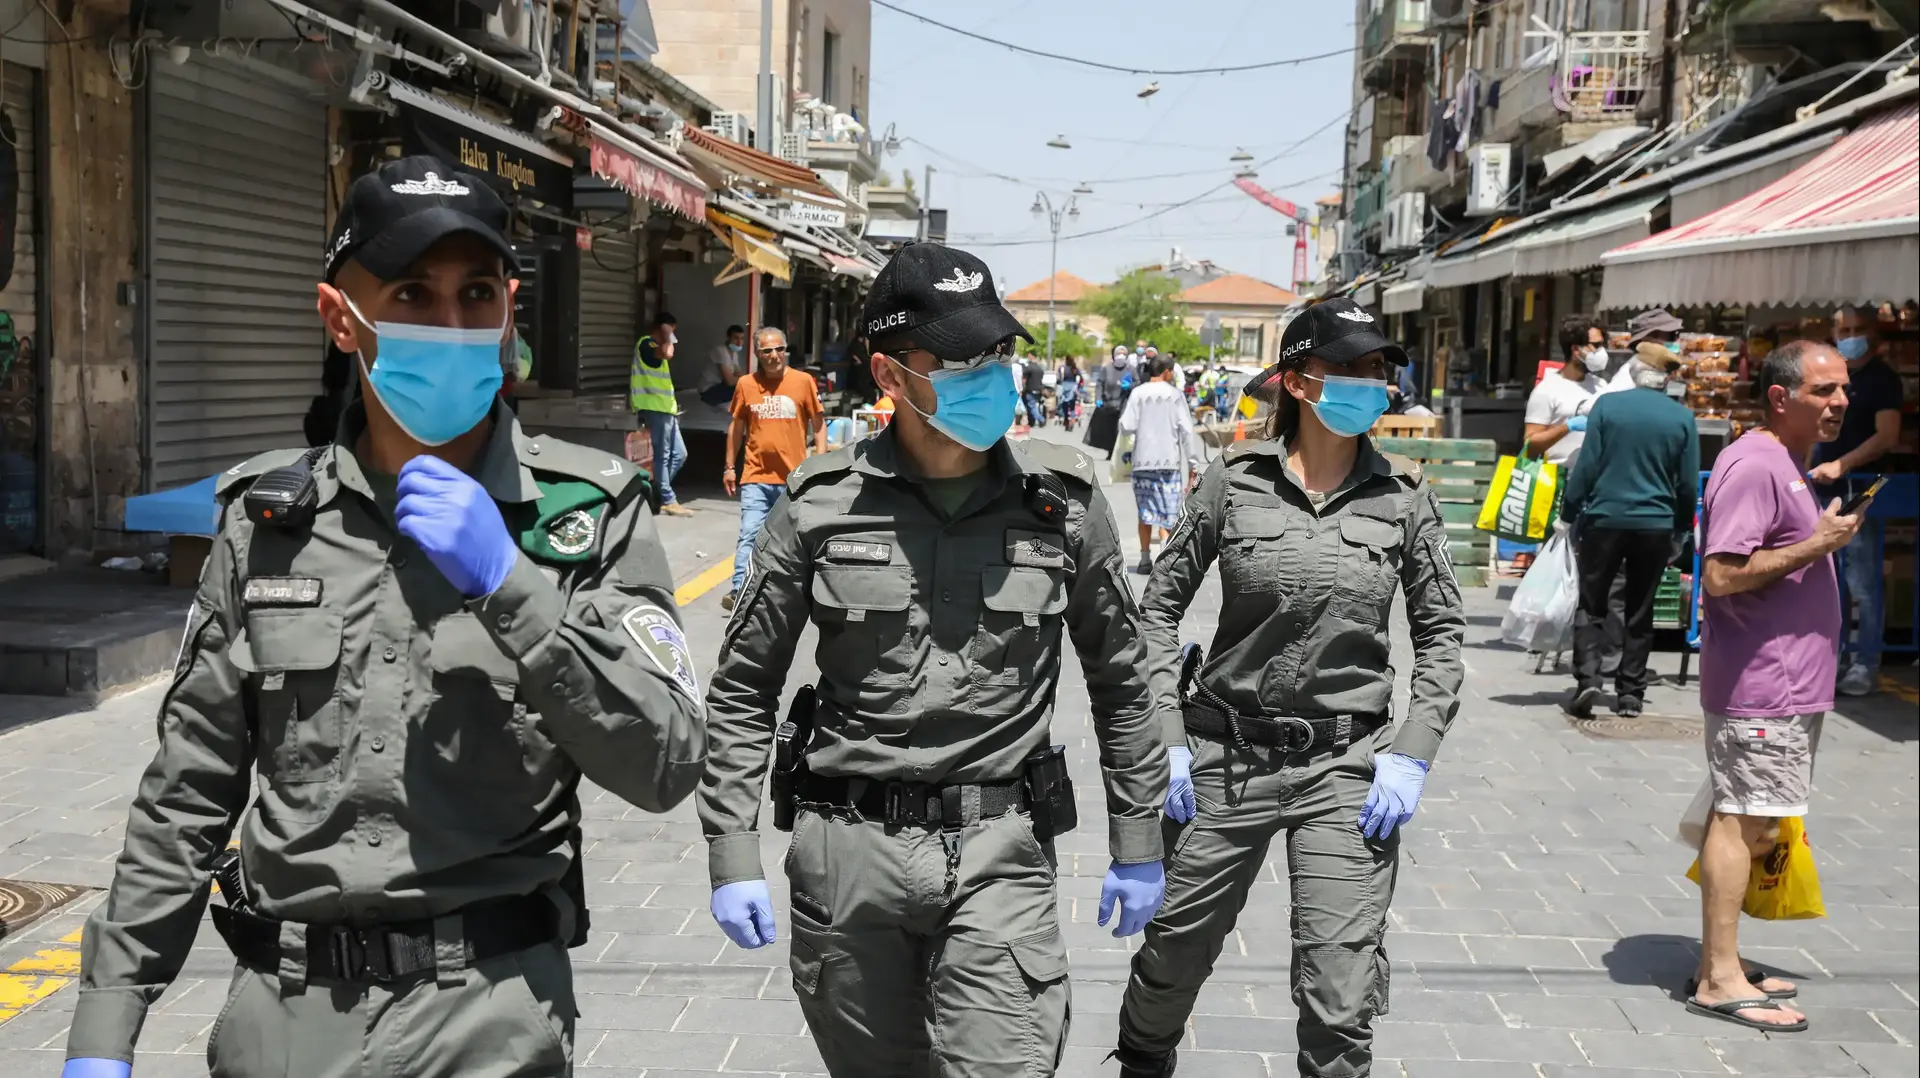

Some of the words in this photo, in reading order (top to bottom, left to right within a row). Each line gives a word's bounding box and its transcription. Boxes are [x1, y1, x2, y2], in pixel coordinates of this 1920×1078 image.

[460, 137, 489, 172] Halva
[496, 151, 536, 190] Kingdom
[868, 311, 906, 335] POLICE
[1282, 338, 1312, 361] POLICE
[749, 403, 781, 413] NORTH
[763, 395, 781, 405] THE
[758, 410, 781, 420] FACE
